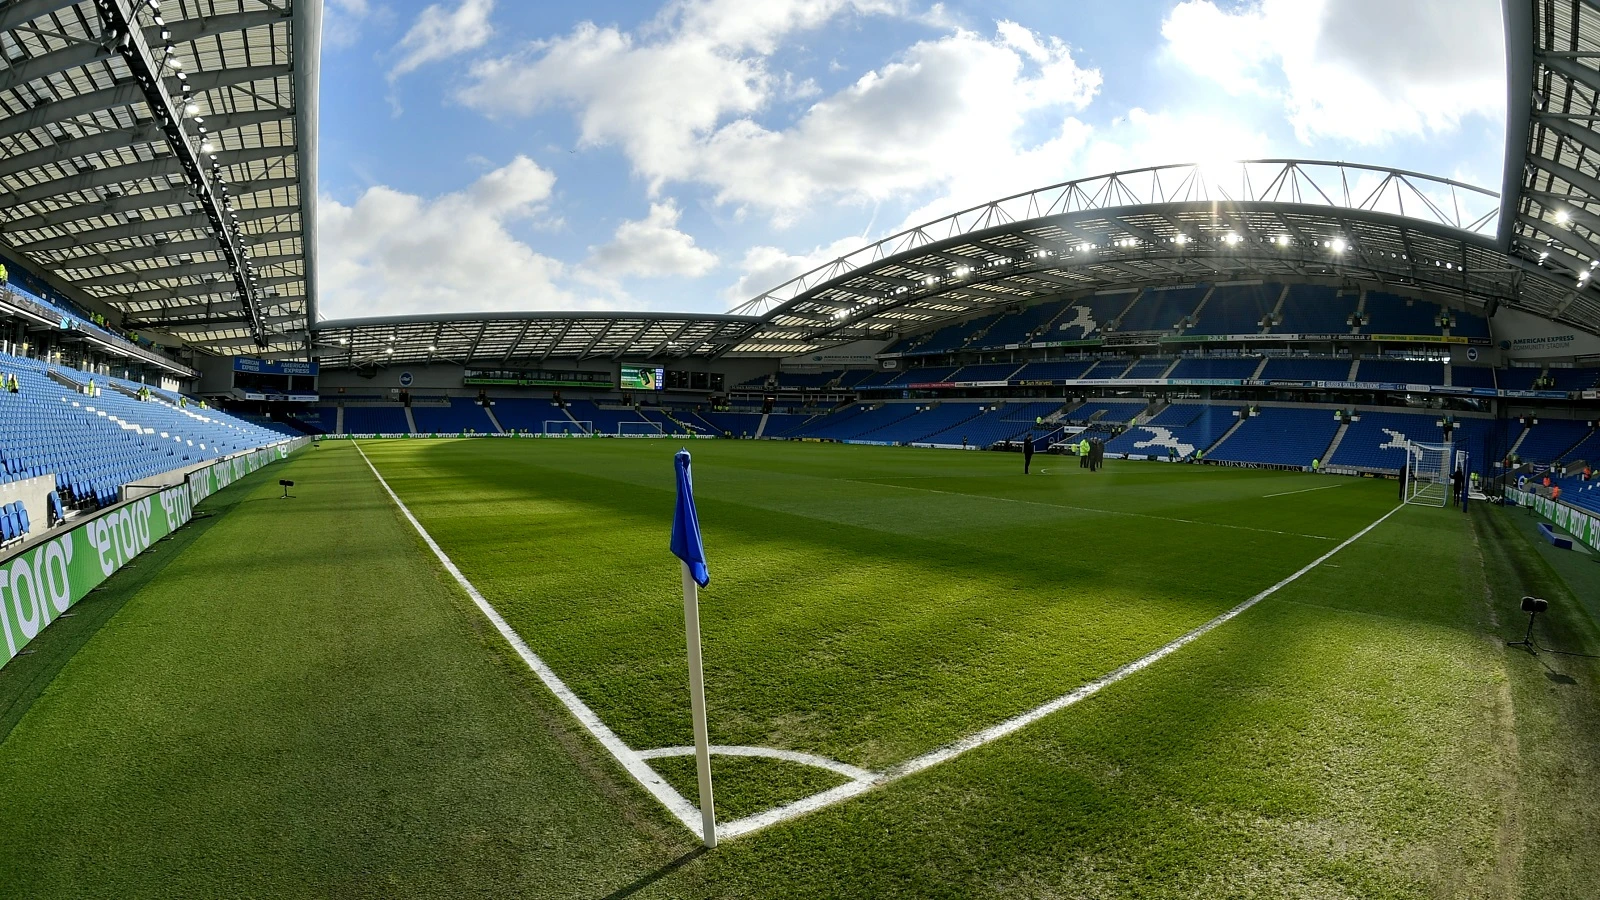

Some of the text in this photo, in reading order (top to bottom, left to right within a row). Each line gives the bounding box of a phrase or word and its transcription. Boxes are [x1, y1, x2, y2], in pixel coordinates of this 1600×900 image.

[1514, 337, 1546, 345] AMERICAN
[1513, 341, 1570, 351] COMMUNITY STADIUM
[239, 358, 260, 367] AMERICAN
[241, 364, 260, 372] EXPRESS
[1259, 463, 1301, 472] JEWELLERS
